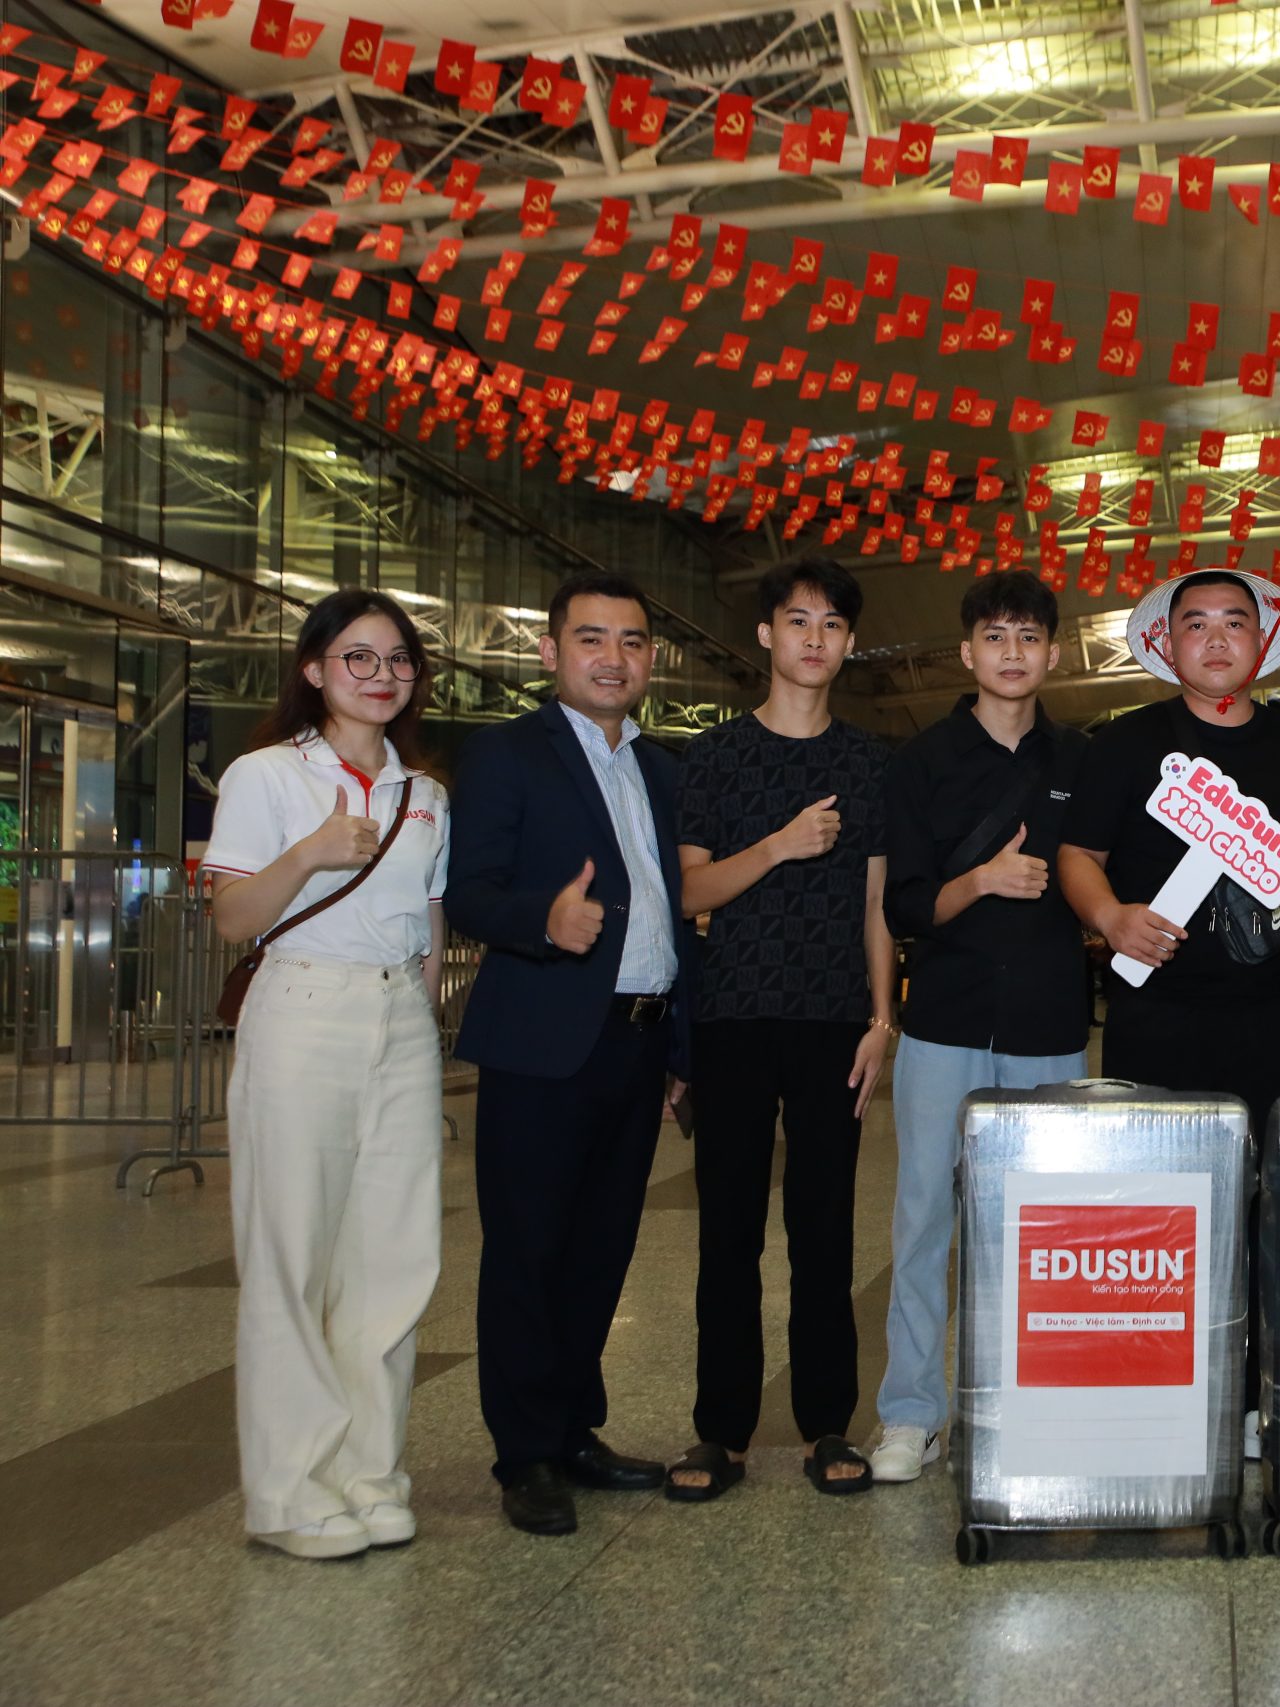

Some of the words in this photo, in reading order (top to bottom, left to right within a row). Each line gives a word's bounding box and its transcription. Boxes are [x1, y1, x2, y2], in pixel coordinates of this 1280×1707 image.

[1210, 832, 1280, 894] chào
[1030, 1249, 1184, 1281] EDUSUN
[1114, 1285, 1130, 1295] tạo
[1131, 1284, 1157, 1294] thành
